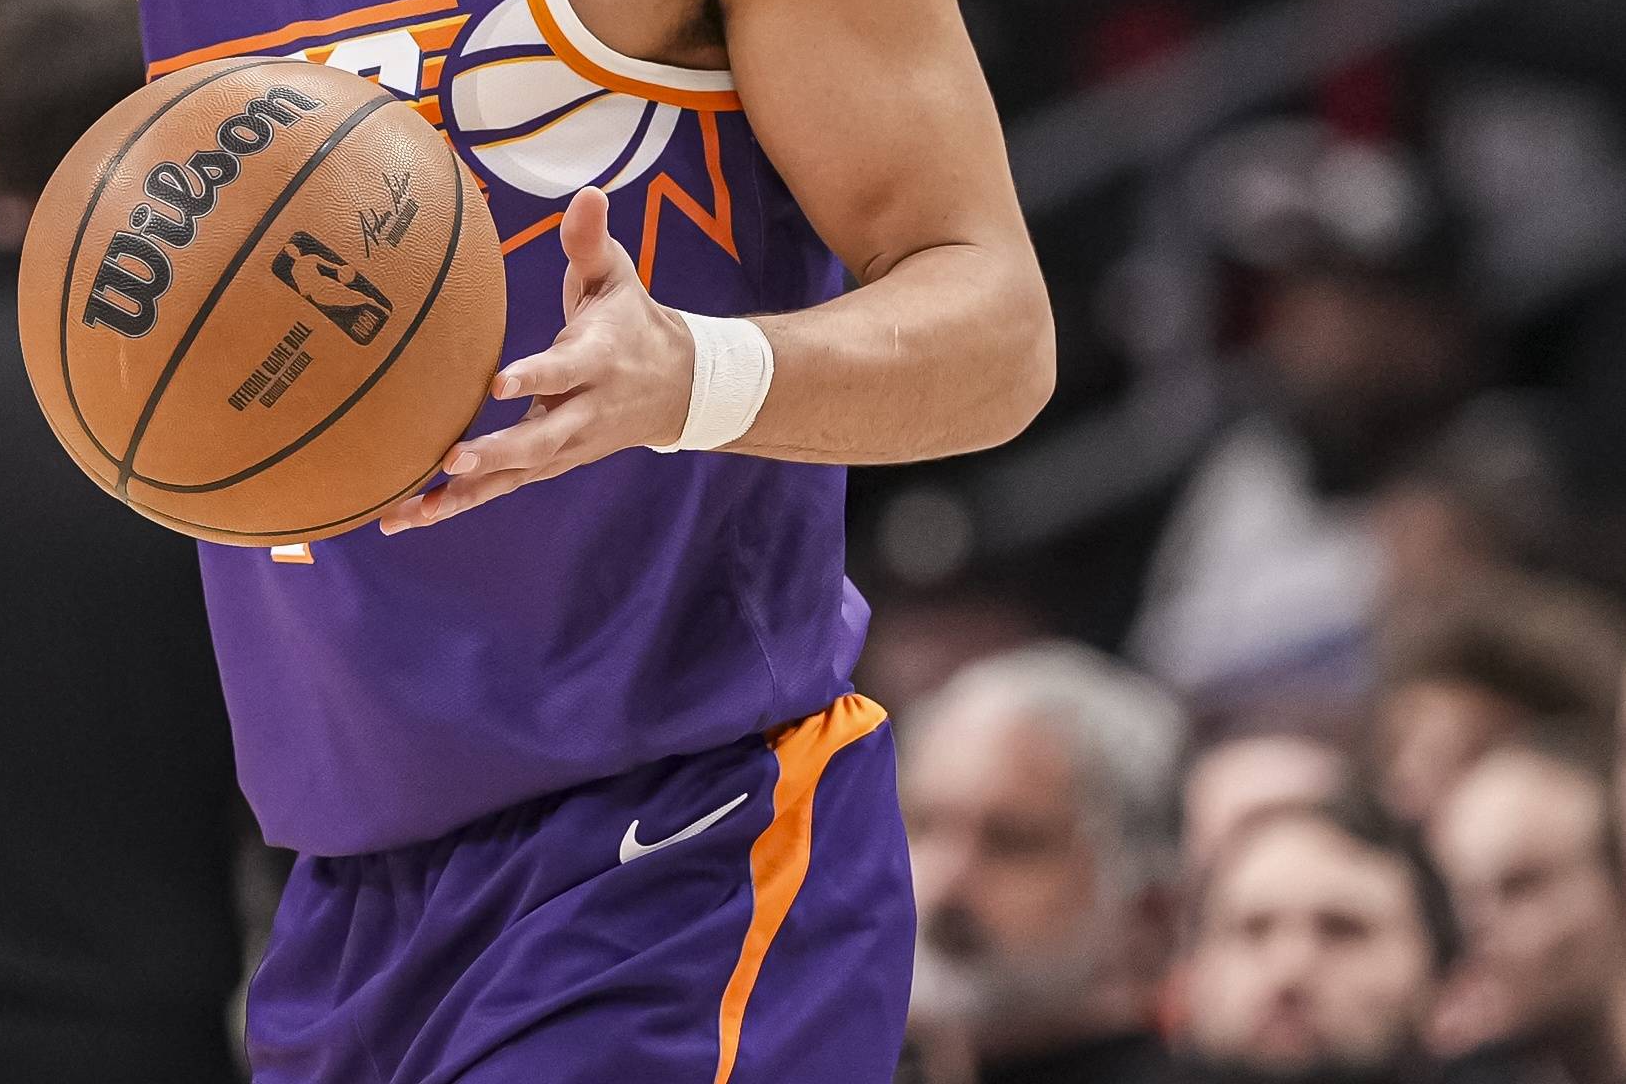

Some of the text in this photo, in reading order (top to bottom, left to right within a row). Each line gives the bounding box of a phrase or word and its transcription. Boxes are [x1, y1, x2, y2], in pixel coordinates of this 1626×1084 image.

[82, 85, 326, 339] Wilson
[227, 320, 314, 412] OFFICIAL GAME BALL
[282, 350, 314, 385] LEATHER
